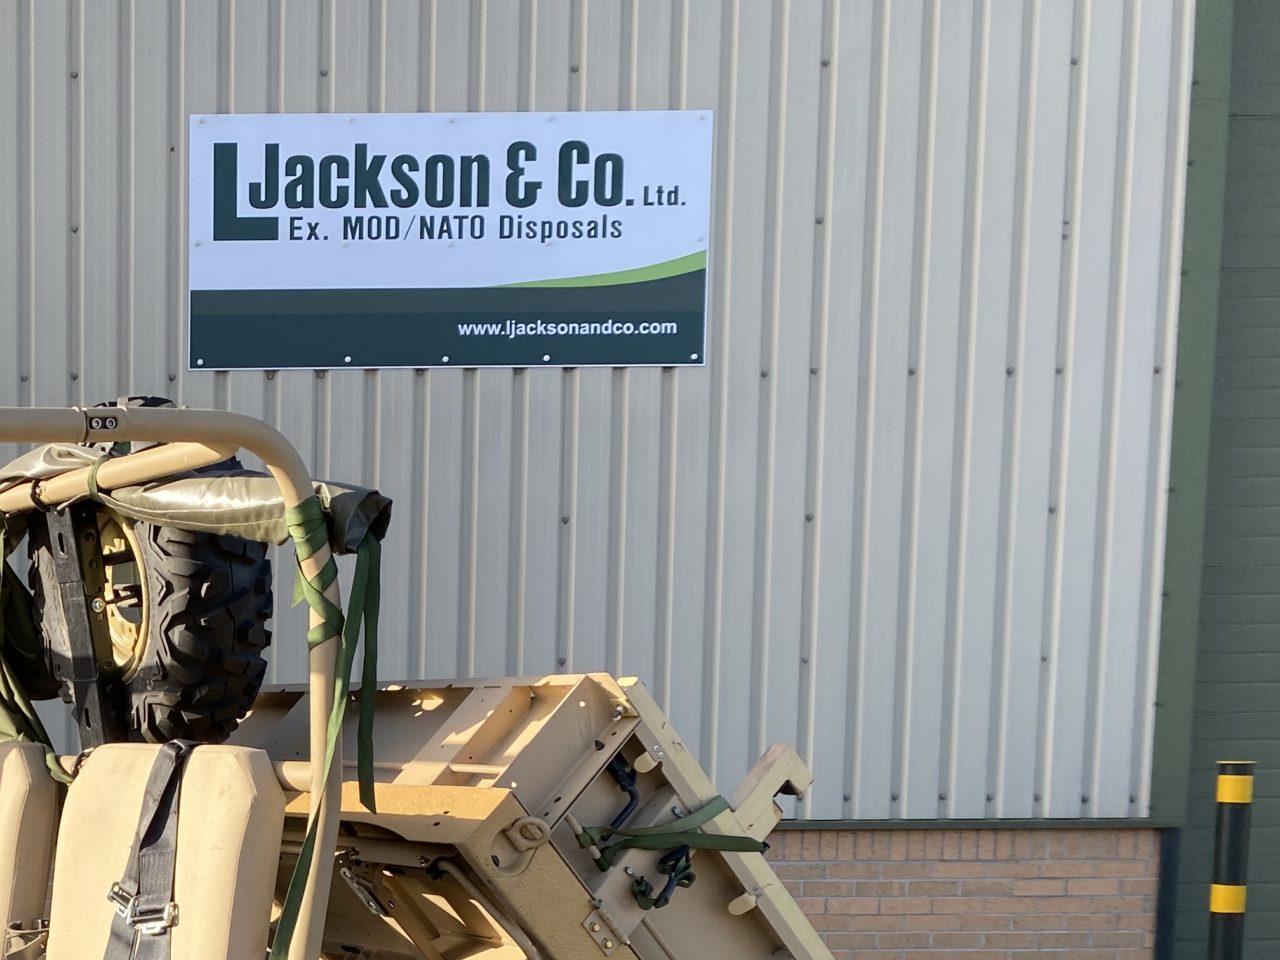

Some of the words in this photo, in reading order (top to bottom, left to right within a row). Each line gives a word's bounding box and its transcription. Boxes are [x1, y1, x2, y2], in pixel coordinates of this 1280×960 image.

[506, 140, 542, 208] &
[557, 140, 635, 208] Co.
[643, 185, 687, 207] Ltd.
[289, 216, 329, 241] Ex.
[342, 215, 486, 241] MOD/NATO
[499, 214, 623, 243] Disposals
[457, 318, 678, 338] www.ljacksonandco.com
